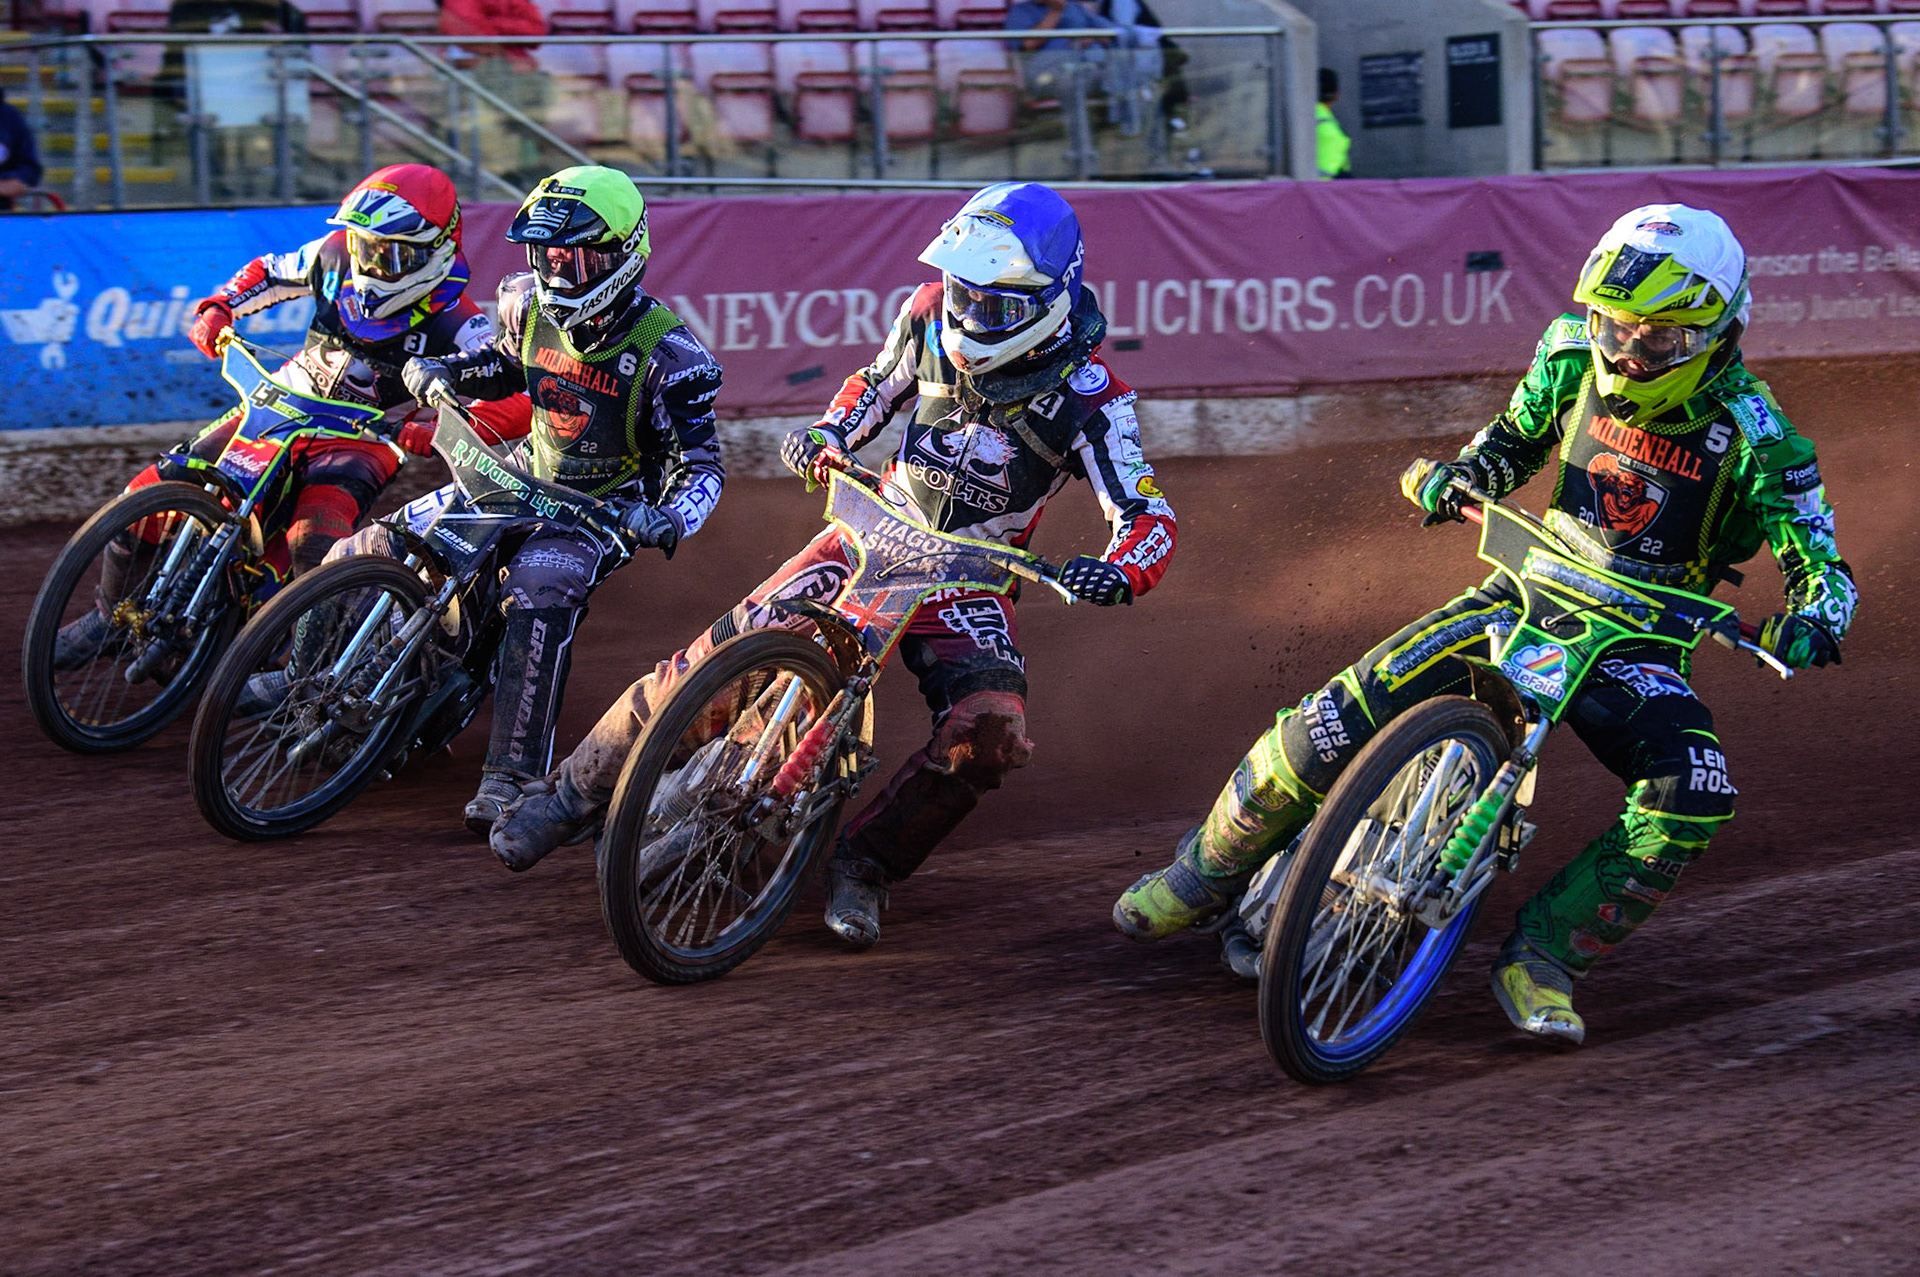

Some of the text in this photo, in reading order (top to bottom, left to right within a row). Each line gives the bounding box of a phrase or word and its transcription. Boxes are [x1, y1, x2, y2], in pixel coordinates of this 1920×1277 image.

[526, 229, 548, 239] BELL
[1595, 286, 1627, 300] BELL
[534, 346, 620, 398] MILDENHALL
[617, 351, 638, 377] 6
[1035, 391, 1060, 416] 4
[580, 440, 598, 453] 22
[1586, 414, 1702, 482] MILDENHALL
[1704, 421, 1733, 454] 5
[224, 449, 269, 472] debut
[1617, 453, 1659, 477] FEN TIGERS
[474, 452, 533, 501] Warren
[908, 454, 1010, 513] COLTS
[433, 525, 479, 554] JOHN
[1578, 505, 1664, 556] 20 22
[1499, 660, 1565, 701] saleFaith
[1317, 689, 1350, 747] TERRY
